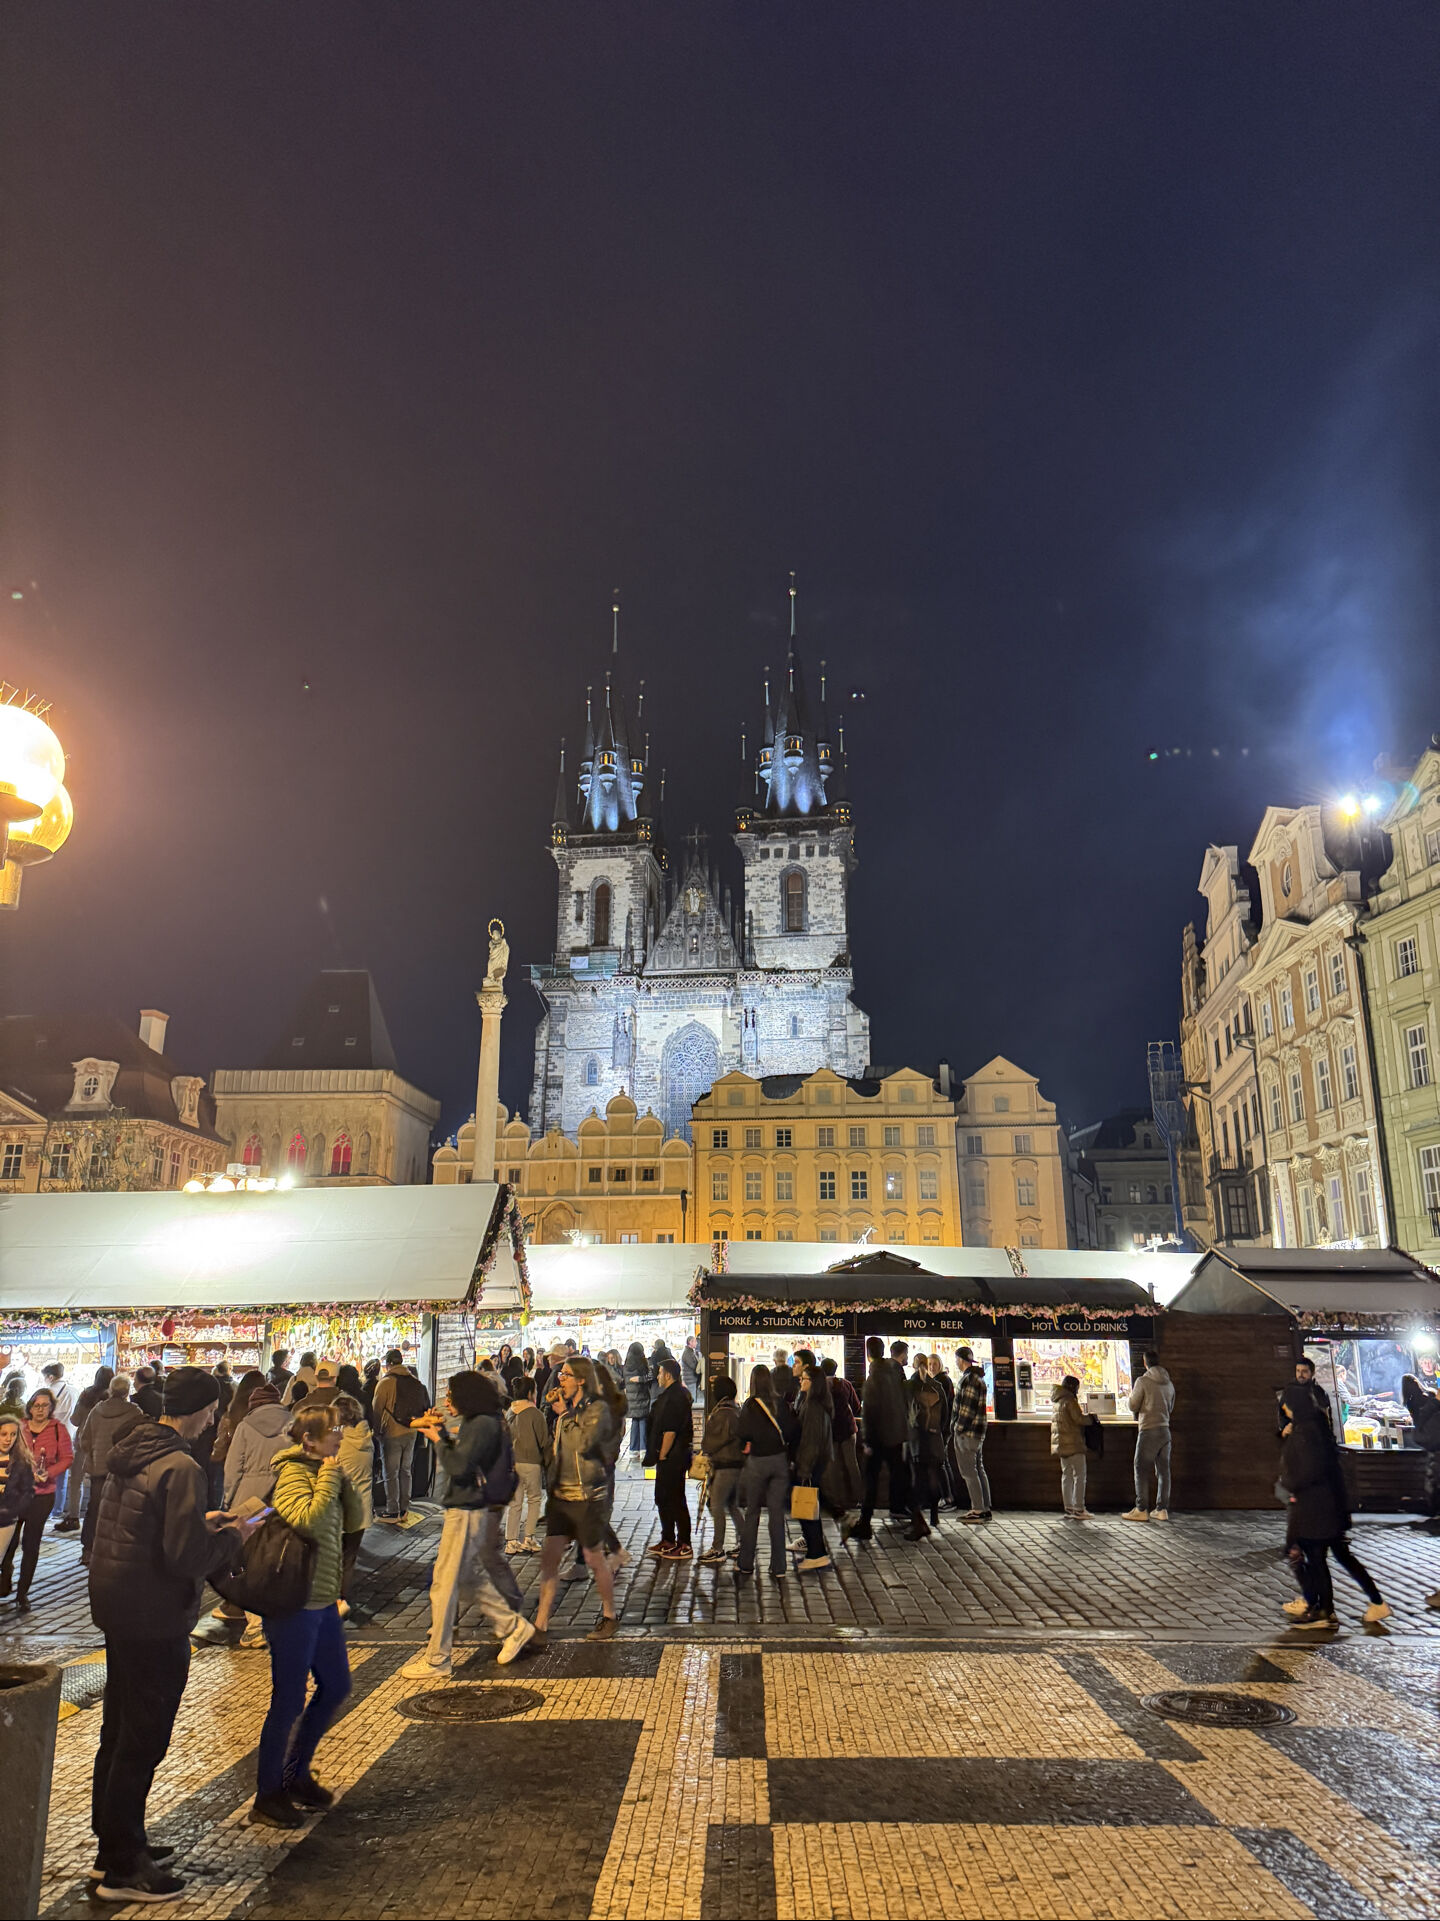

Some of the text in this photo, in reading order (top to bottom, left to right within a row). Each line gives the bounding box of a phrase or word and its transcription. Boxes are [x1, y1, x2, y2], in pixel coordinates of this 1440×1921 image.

[719, 1315, 752, 1326] HORKÉ
[762, 1316, 806, 1327] STUDENÉ
[807, 1316, 845, 1329] NÁPOJE
[903, 1319, 964, 1330] PIVO BEER
[1031, 1322, 1053, 1331] HOT
[1063, 1322, 1091, 1332] COLD
[1093, 1322, 1129, 1332] DRINKS
